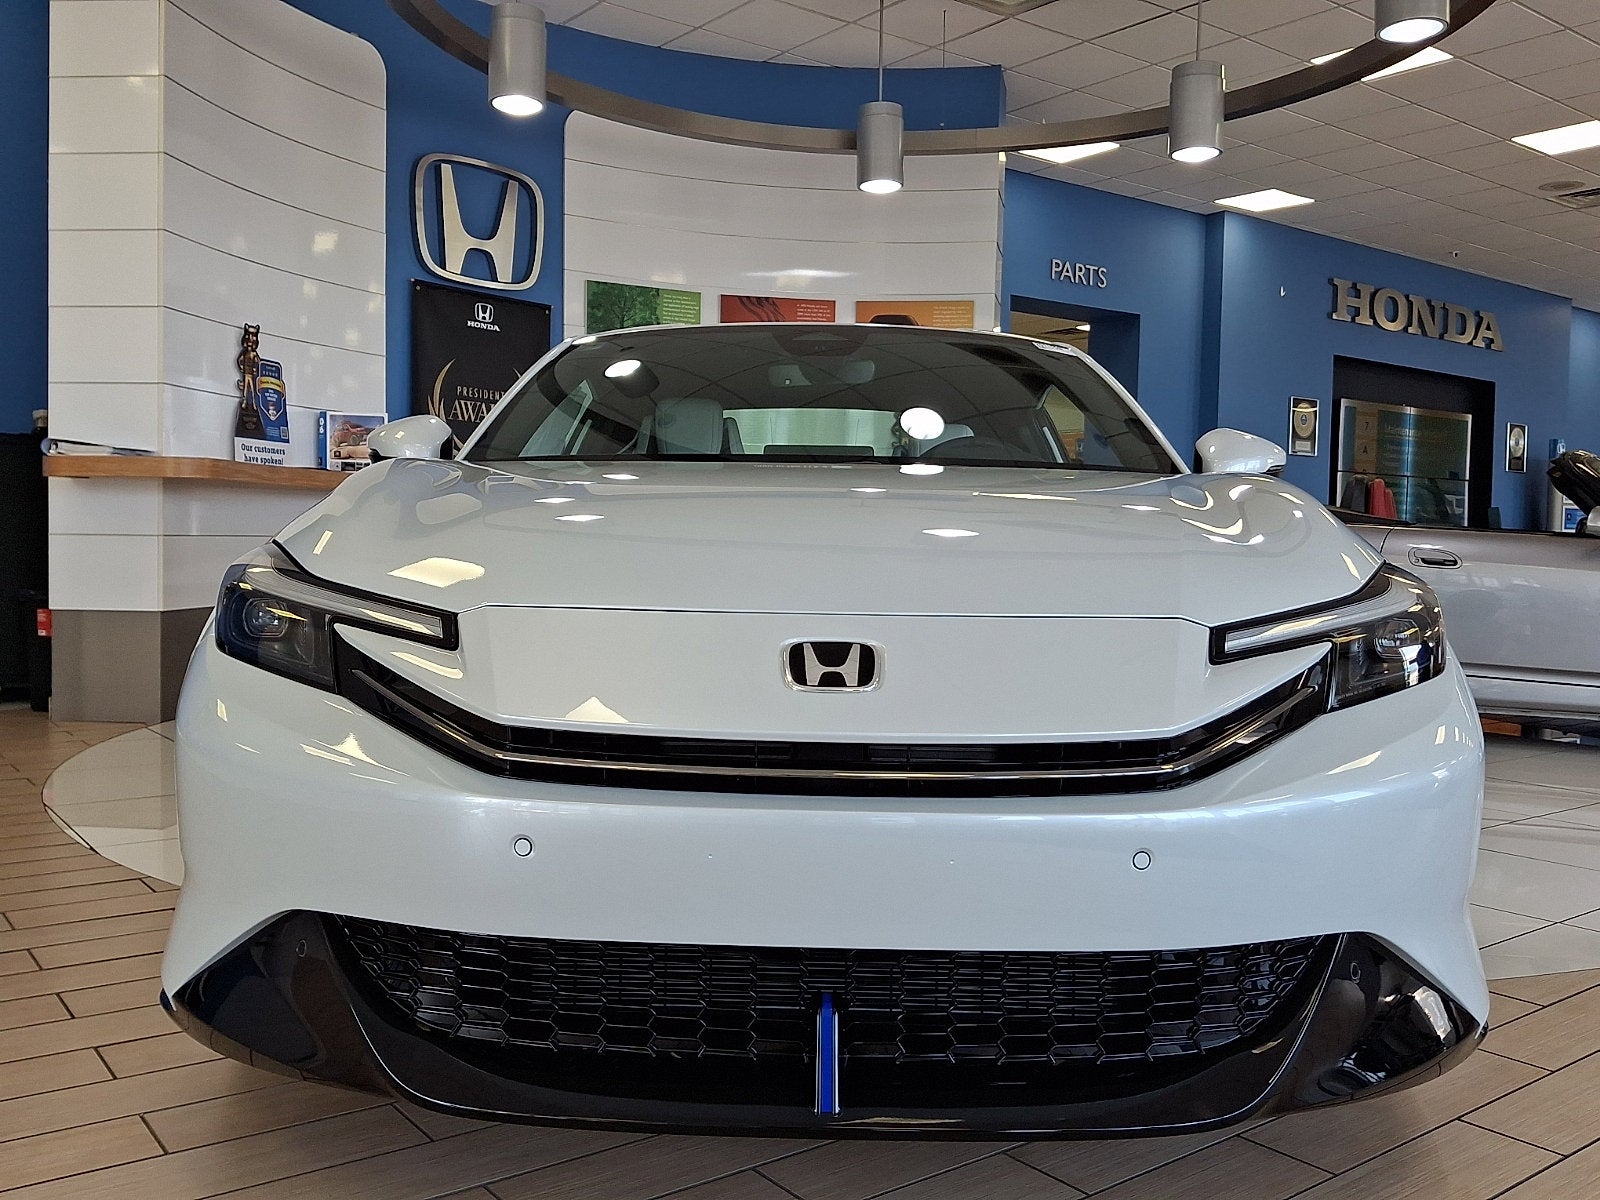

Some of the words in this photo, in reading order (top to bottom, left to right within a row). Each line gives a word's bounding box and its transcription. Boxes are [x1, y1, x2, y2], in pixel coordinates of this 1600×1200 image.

[1051, 258, 1107, 288] PARTS
[1329, 277, 1505, 352] HONDA
[467, 320, 501, 332] HONDA
[241, 443, 252, 452] Our
[254, 445, 286, 456] customers
[244, 453, 258, 463] have
[260, 456, 284, 466] spoken!
